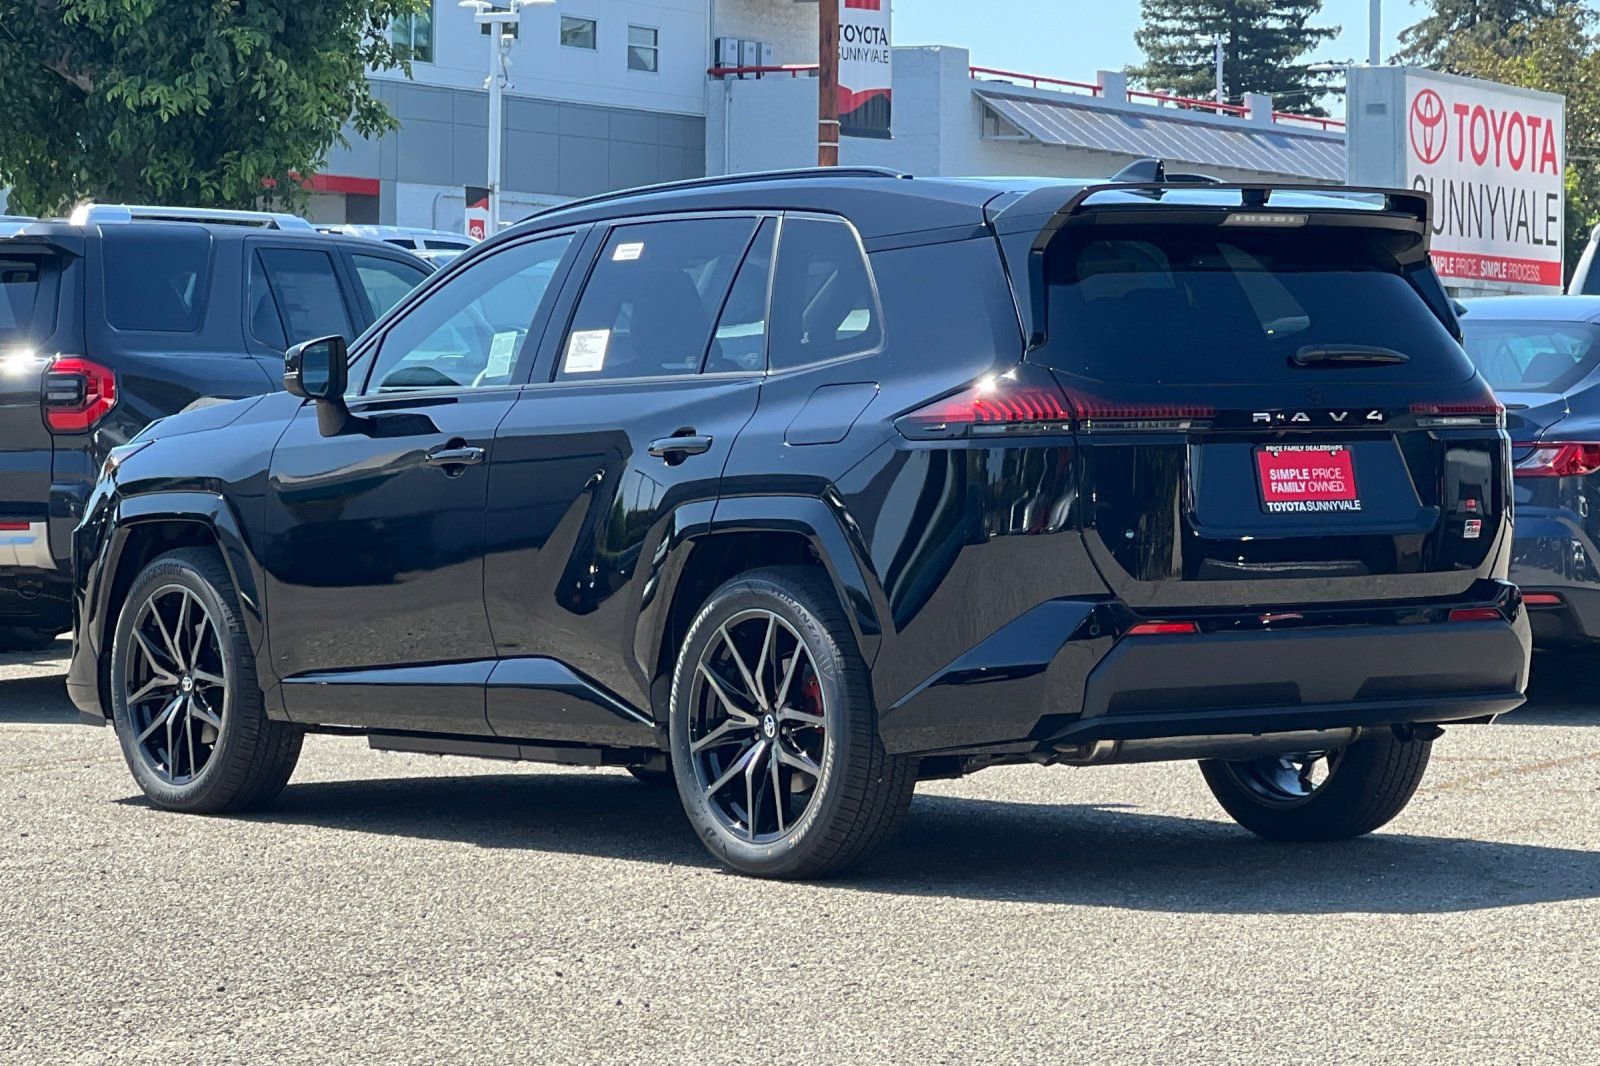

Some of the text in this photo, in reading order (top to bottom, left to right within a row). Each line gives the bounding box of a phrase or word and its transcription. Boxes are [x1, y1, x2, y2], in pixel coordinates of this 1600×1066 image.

[1453, 103, 1558, 176] TOYOTA
[1431, 255, 1454, 274] MPLE
[1480, 259, 1507, 279] SIMPLE
[1305, 444, 1343, 452] DEALERSHIPS
[1269, 467, 1345, 480] SIMPLE PRICE.
[1270, 480, 1347, 493] FAMILY OWNED.
